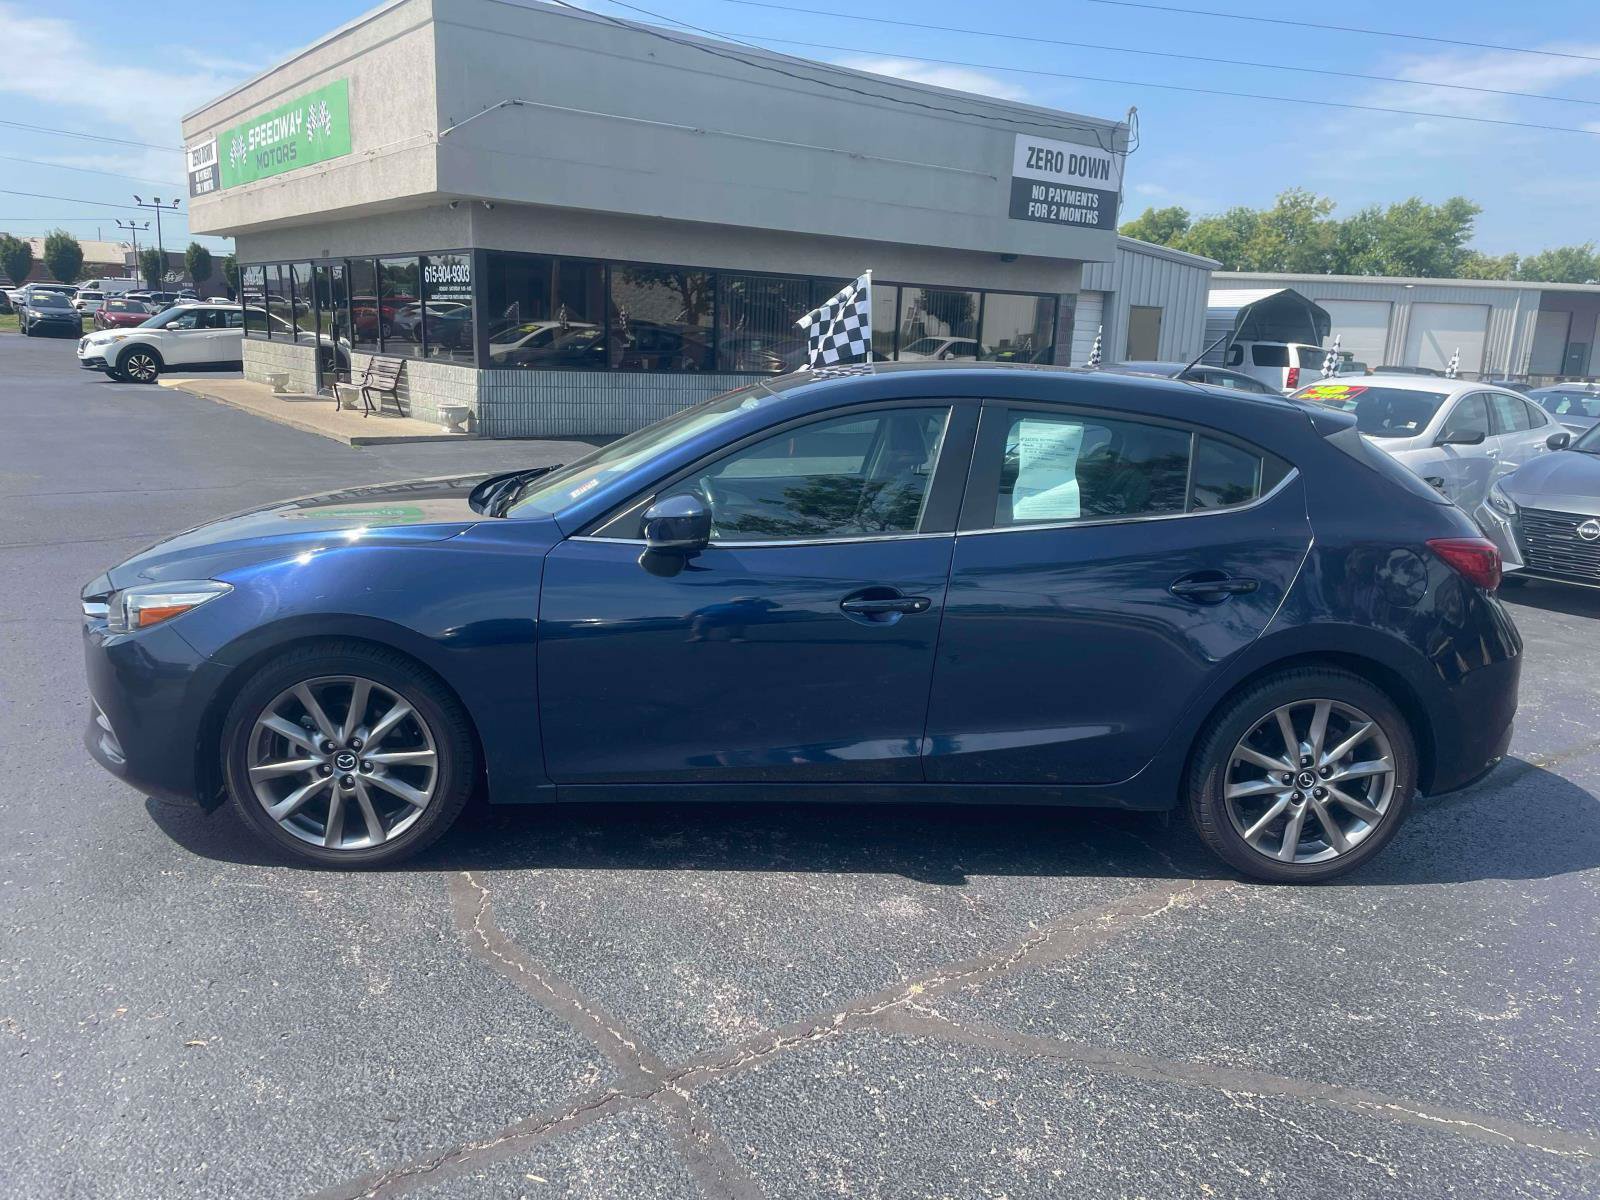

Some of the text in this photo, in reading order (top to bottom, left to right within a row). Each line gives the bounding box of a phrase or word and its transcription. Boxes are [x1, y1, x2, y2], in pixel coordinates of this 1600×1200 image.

[248, 108, 303, 151] SPEEDWAY
[256, 141, 297, 170] MOTORS
[1026, 146, 1110, 181] ZERO DOWN
[1032, 184, 1099, 208] NO PAYMENTS
[1028, 202, 1099, 225] FOR 2 MONTHS
[424, 264, 470, 283] 615-904-9303
